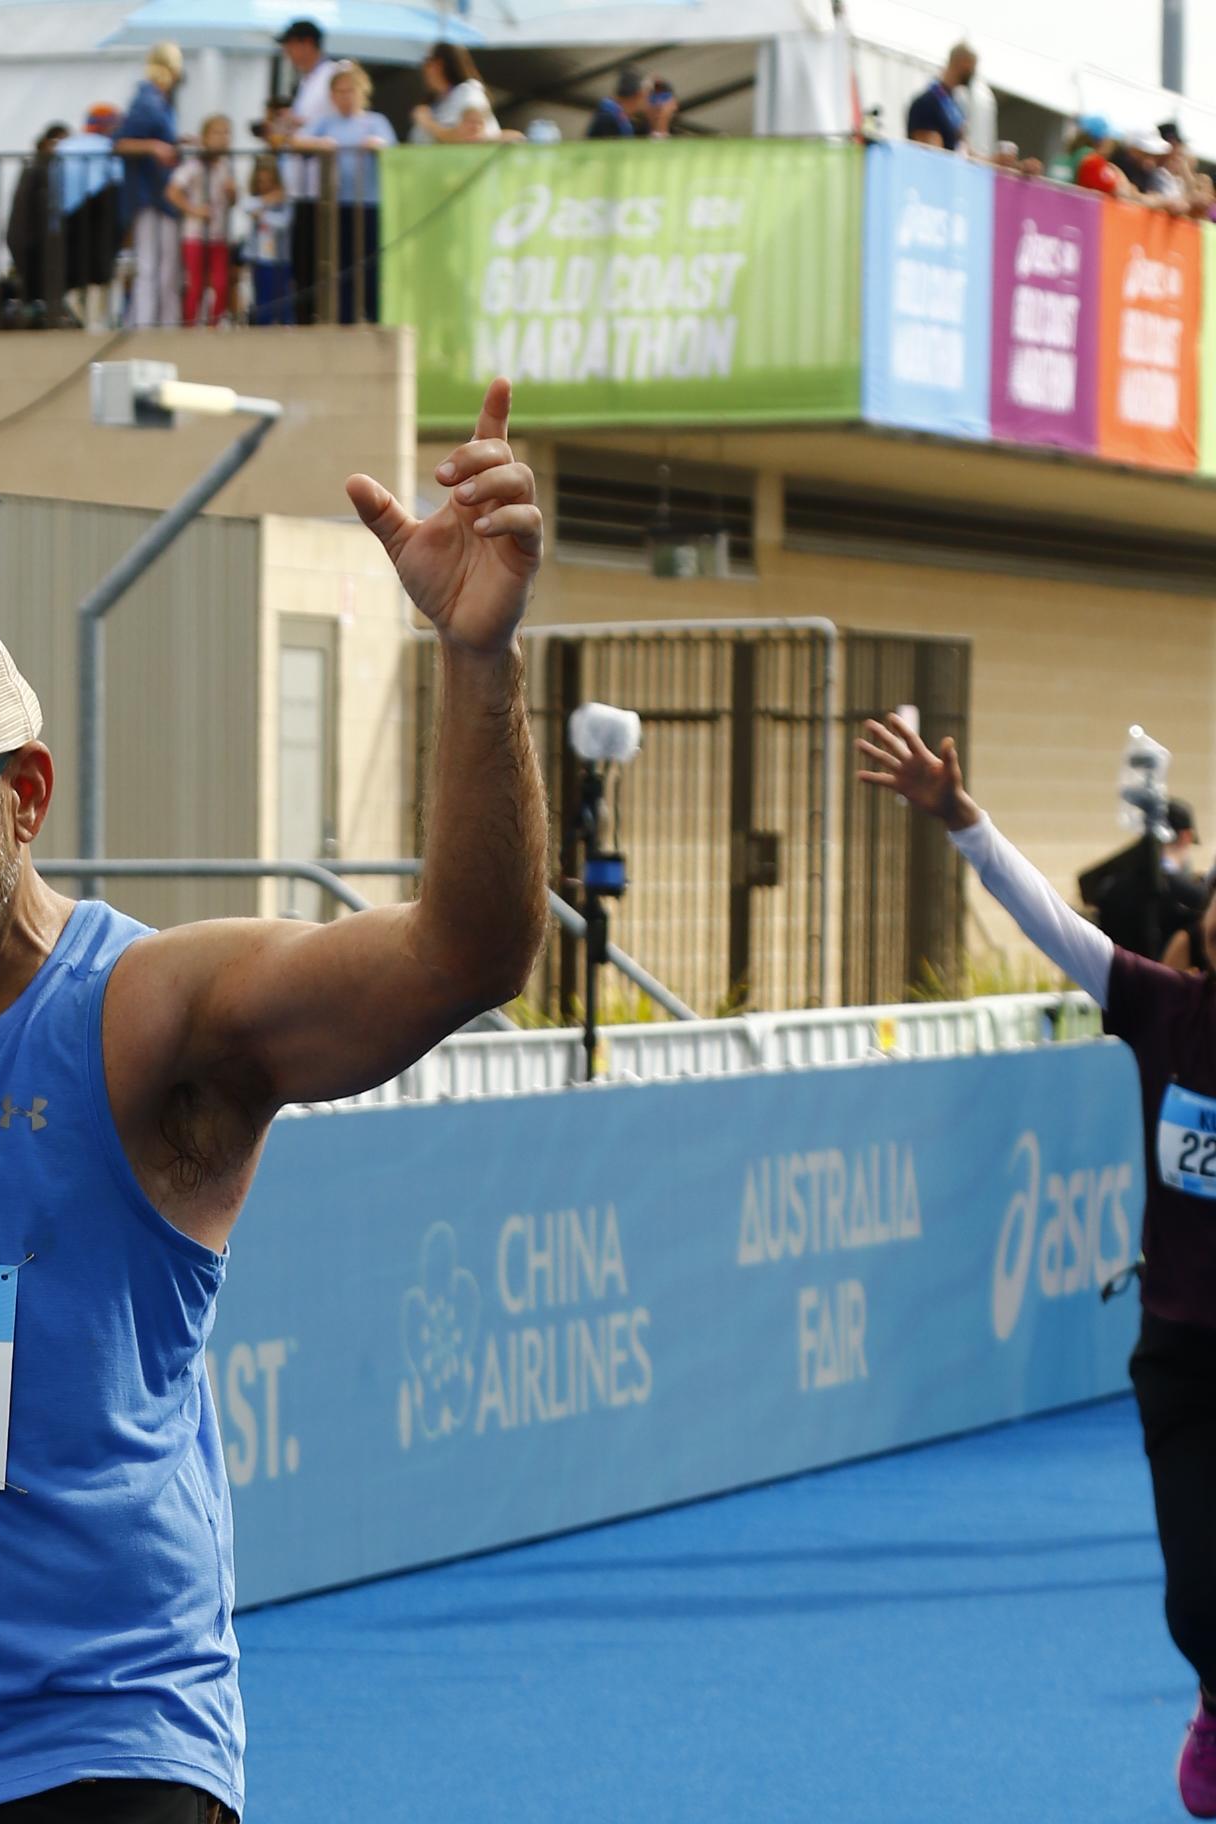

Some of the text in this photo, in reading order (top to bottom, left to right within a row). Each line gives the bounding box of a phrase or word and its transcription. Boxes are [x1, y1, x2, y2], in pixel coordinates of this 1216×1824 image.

[481, 252, 746, 315] GOLD COAST
[472, 315, 737, 383] MARATHON
[497, 1201, 628, 1315] CHINA
[737, 1142, 922, 1266] AUSTRALIA
[1039, 1162, 1132, 1297] asics
[474, 1306, 652, 1434] AIRLINES
[798, 1279, 869, 1391] FAIR
